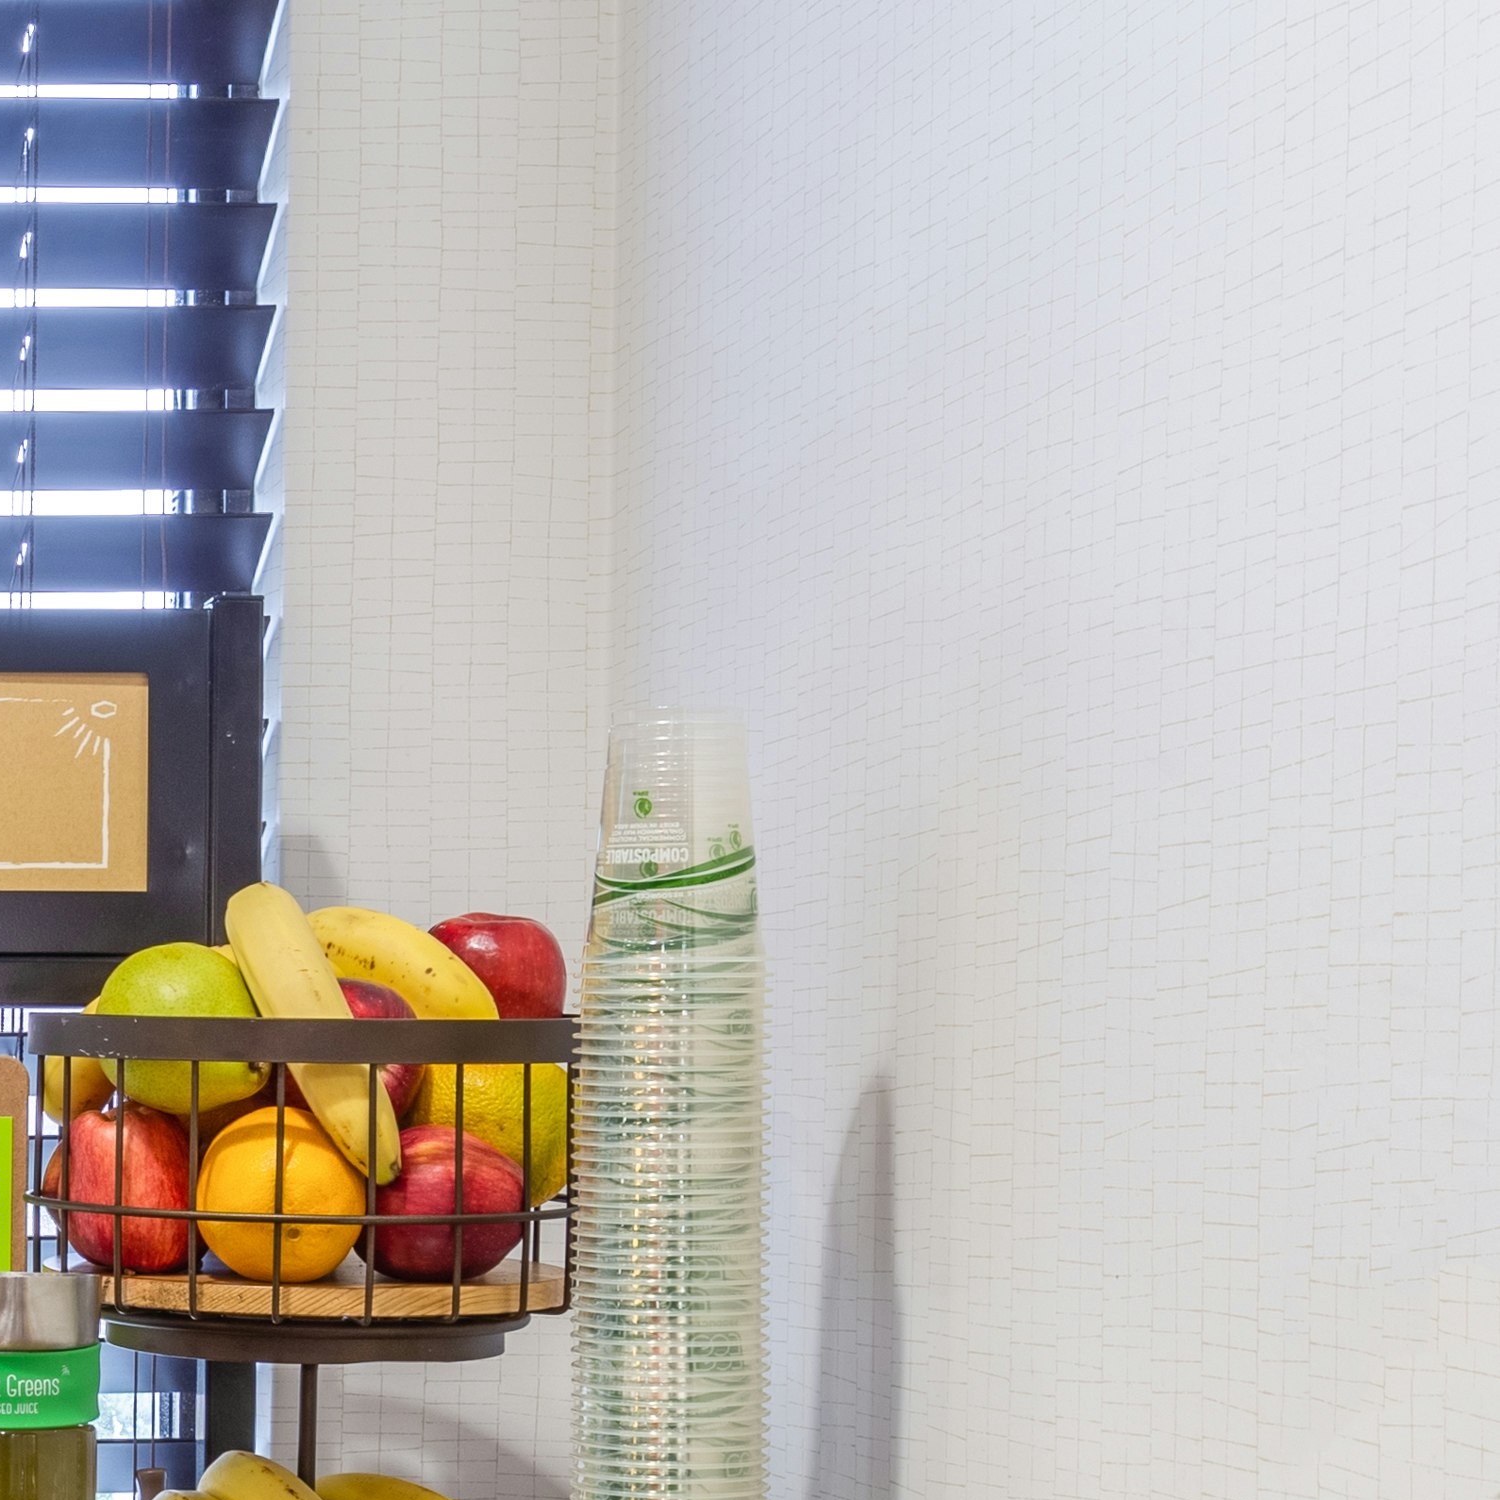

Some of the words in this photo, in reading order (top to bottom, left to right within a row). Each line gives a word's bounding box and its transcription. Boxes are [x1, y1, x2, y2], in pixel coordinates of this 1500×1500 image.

[606, 847, 689, 864] COMPOSTABLE
[6, 1374, 60, 1397] Greens
[14, 1402, 39, 1415] JUICE
